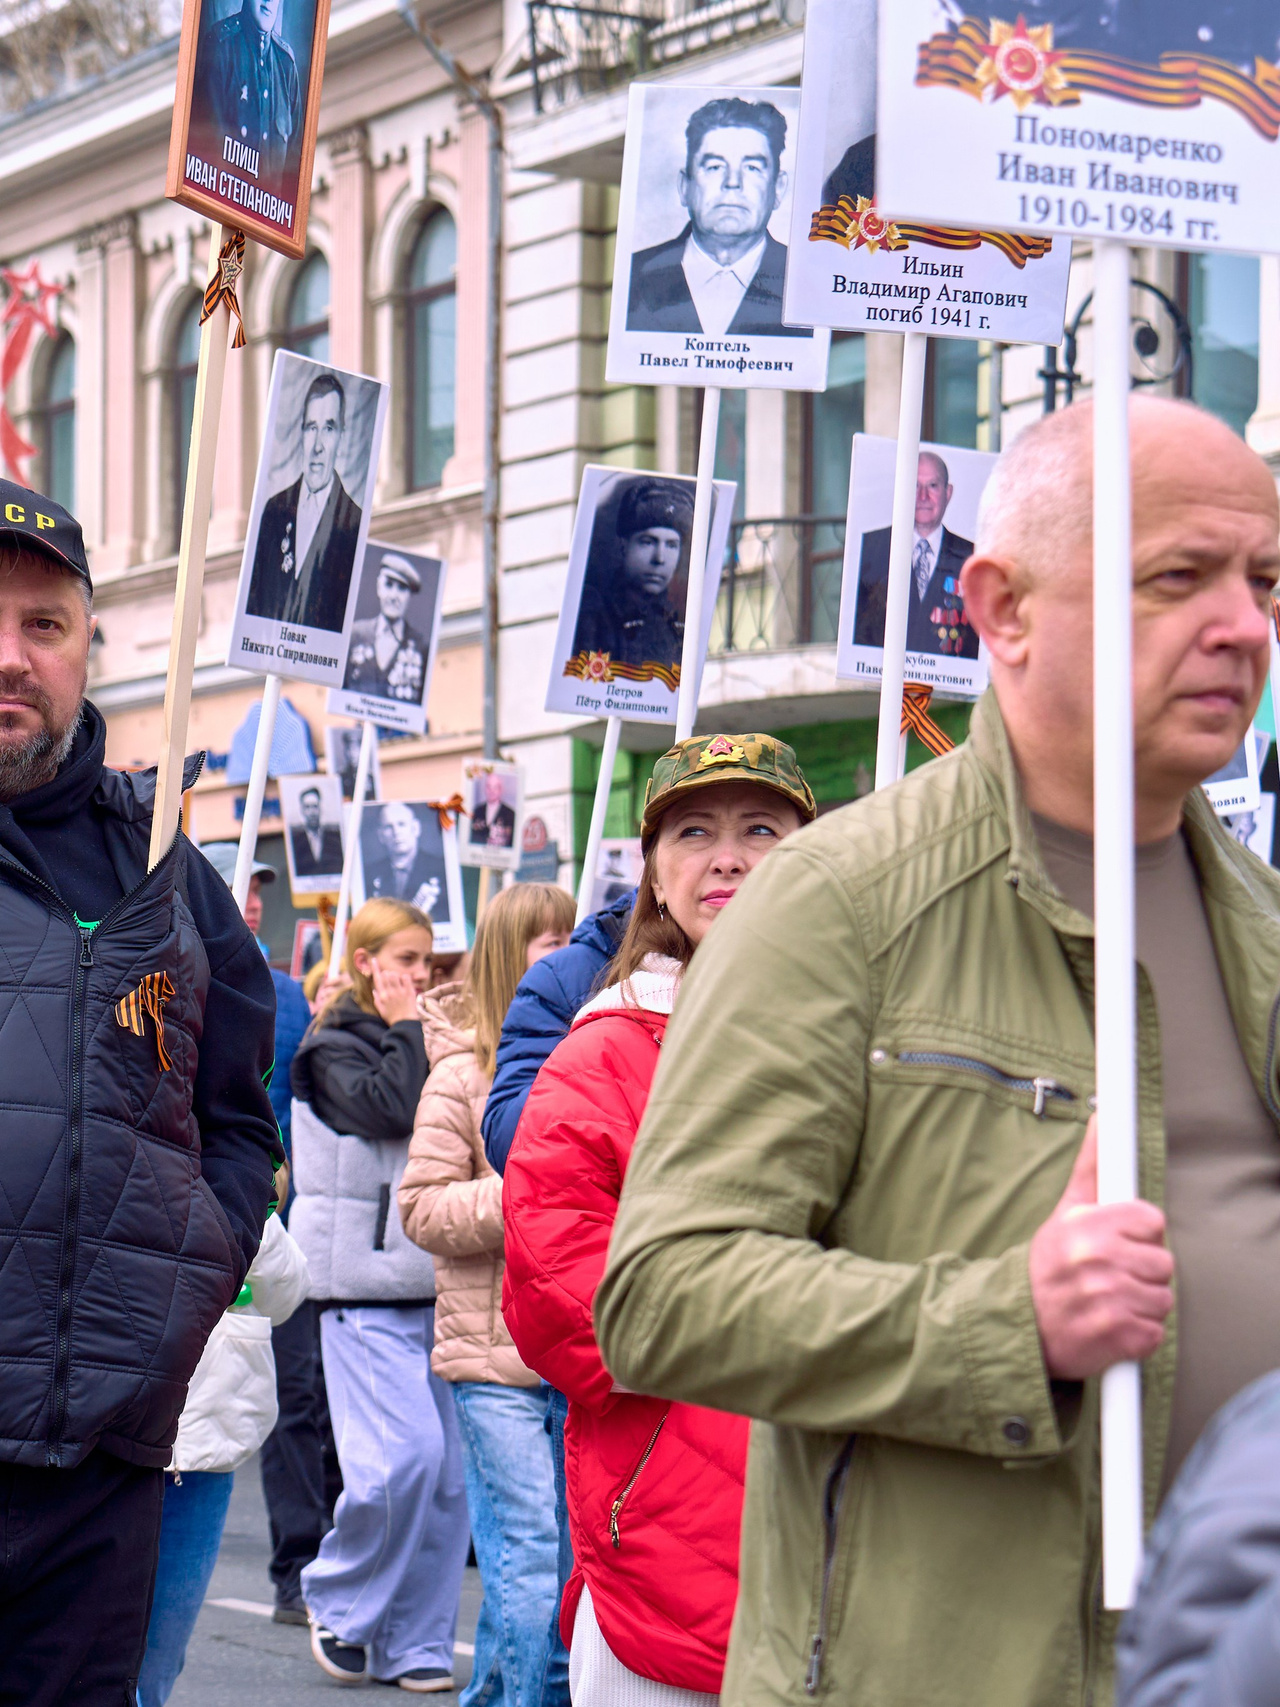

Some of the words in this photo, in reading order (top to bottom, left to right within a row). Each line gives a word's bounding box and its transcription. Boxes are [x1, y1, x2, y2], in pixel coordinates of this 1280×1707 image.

[1012, 115, 1224, 164] Пономаренко
[222, 135, 260, 179] ПЛИЩ
[185, 153, 218, 193] ИВАН
[218, 170, 293, 229] СТЕПАНОВИЧ
[997, 153, 1076, 188] Иван
[1086, 161, 1240, 205] Иванович
[1017, 194, 1175, 236] 1910-1984
[1184, 217, 1221, 241] гг.
[902, 255, 964, 278] Ильин
[831, 274, 931, 304] Владимир
[936, 283, 1028, 308] Агапович
[866, 304, 924, 325] погиб
[930, 306, 972, 328] 1941
[978, 314, 991, 329] г.
[685, 337, 751, 353] Коптель
[639, 353, 689, 368] Павел
[694, 354, 794, 372] Тимофеевич
[279, 626, 307, 644] Новак
[241, 637, 275, 656] Никита
[276, 644, 339, 668] Спиридонович
[905, 654, 936, 668] кубов
[856, 660, 884, 676] Паве
[902, 670, 973, 686] енидиктович
[606, 684, 643, 700] Петров
[575, 695, 601, 710] Пётр
[604, 698, 669, 715] Филиппович
